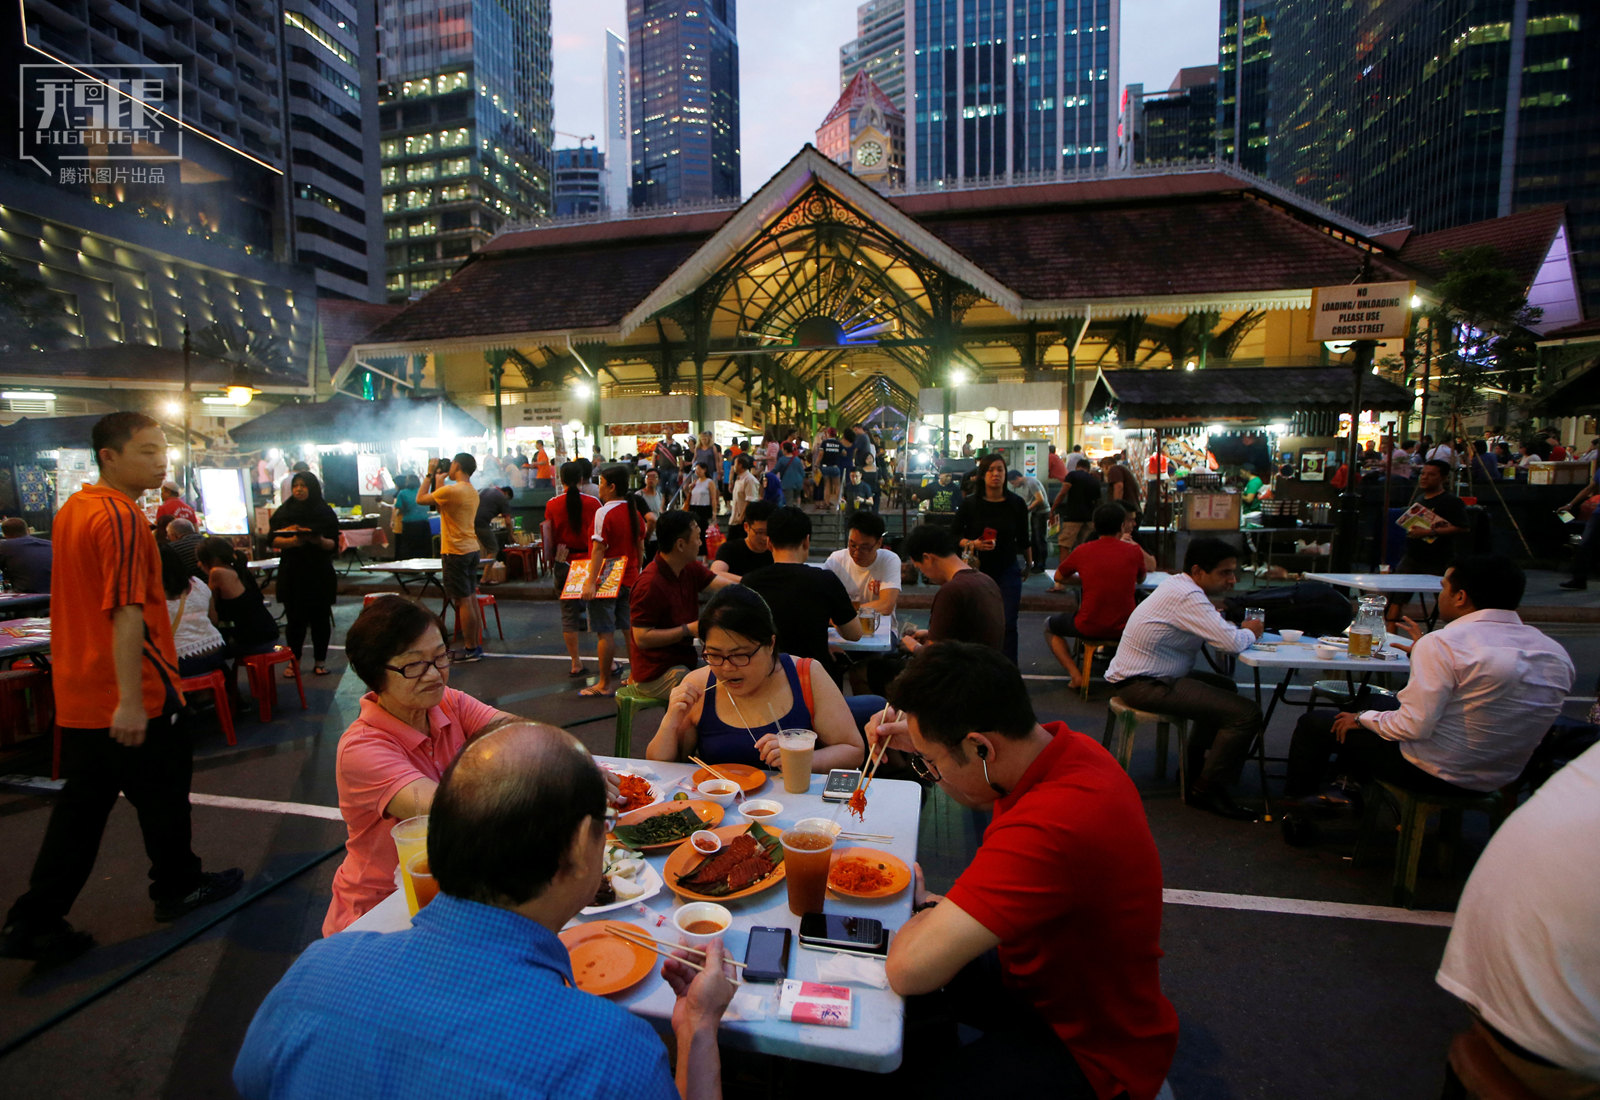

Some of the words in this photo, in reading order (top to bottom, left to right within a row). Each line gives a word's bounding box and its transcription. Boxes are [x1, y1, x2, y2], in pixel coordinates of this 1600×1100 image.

[1356, 287, 1368, 297] NO
[1321, 300, 1356, 312] LOADING/
[1357, 298, 1400, 310] UNLOADING
[1338, 312, 1365, 323] PLEASE
[1365, 311, 1381, 321] USE
[1331, 325, 1356, 336] CROSS
[1357, 323, 1385, 334] STREET
